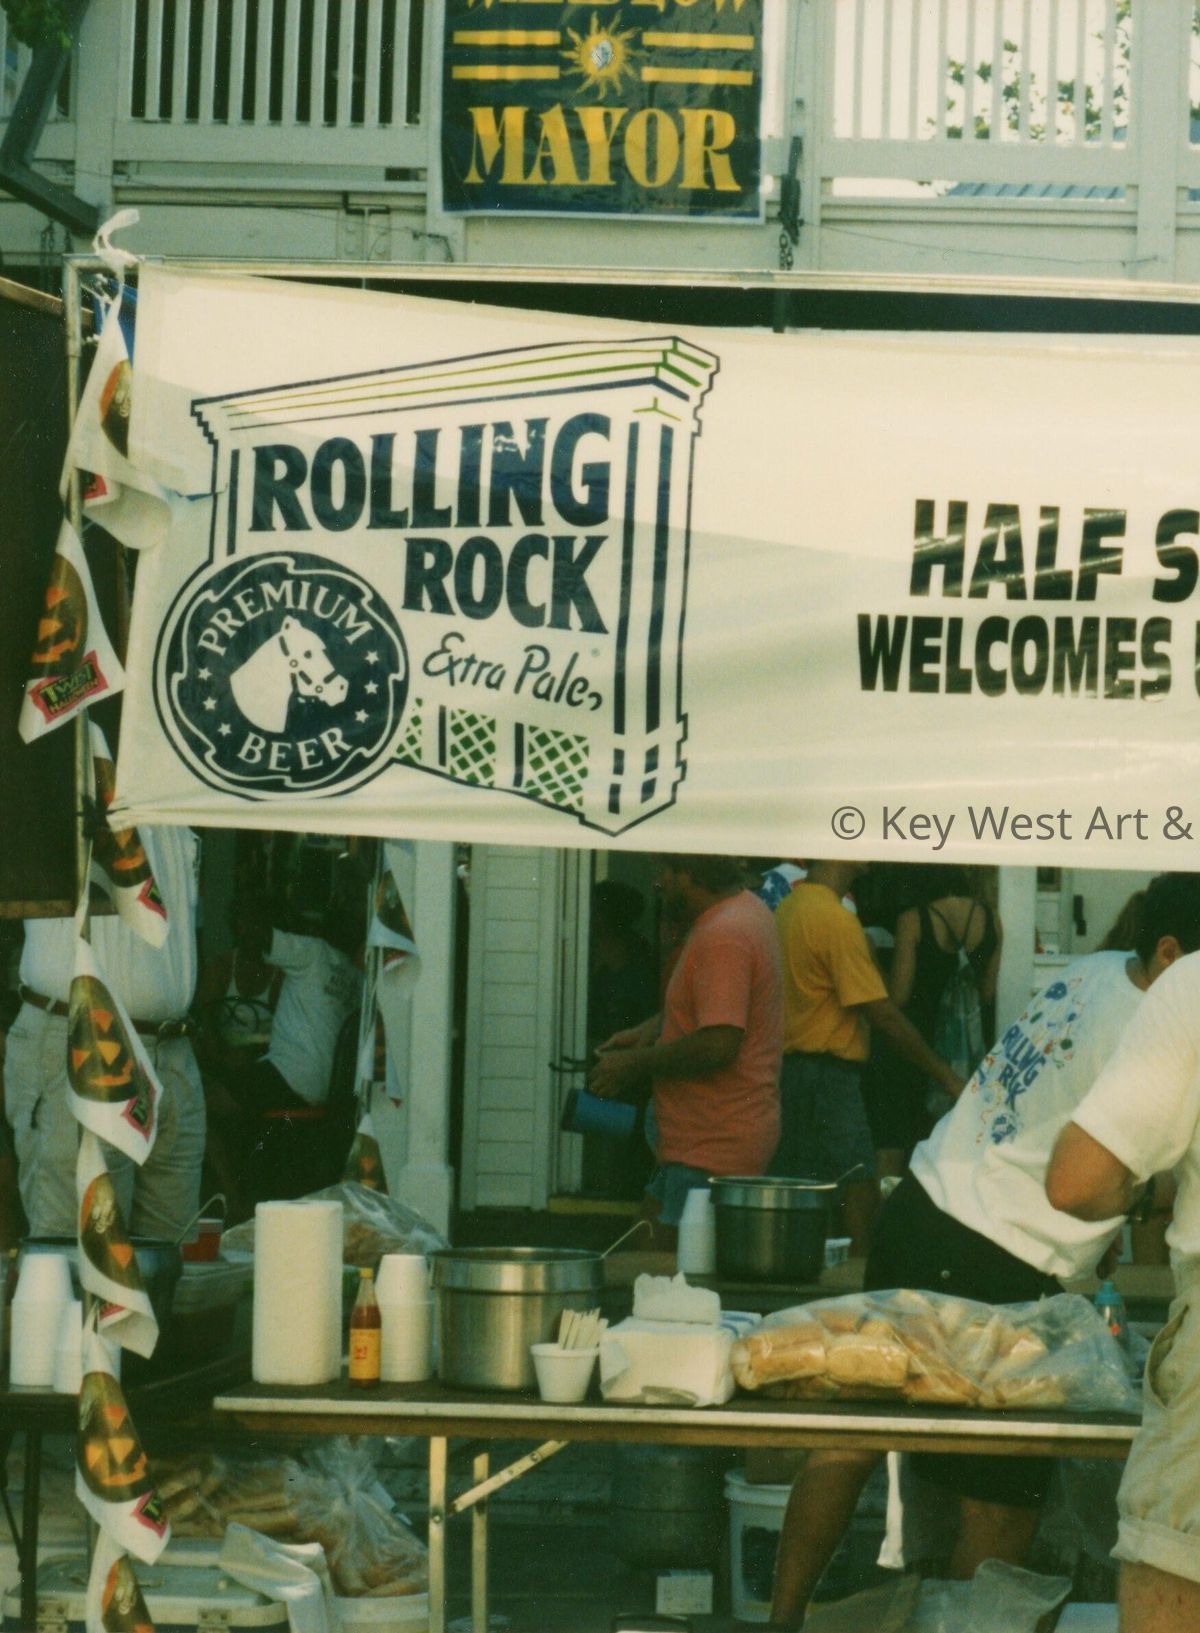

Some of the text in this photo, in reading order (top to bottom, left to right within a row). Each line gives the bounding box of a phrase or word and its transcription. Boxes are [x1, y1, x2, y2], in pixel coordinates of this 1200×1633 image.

[463, 103, 741, 191] MAYOR
[248, 412, 612, 532] ROLLING
[402, 534, 611, 635] ROCK
[909, 498, 1127, 601] HALF
[198, 579, 375, 656] PREMIUM
[422, 631, 507, 692] Extra
[857, 613, 1172, 702] WELCOMES
[236, 724, 352, 773] BEER
